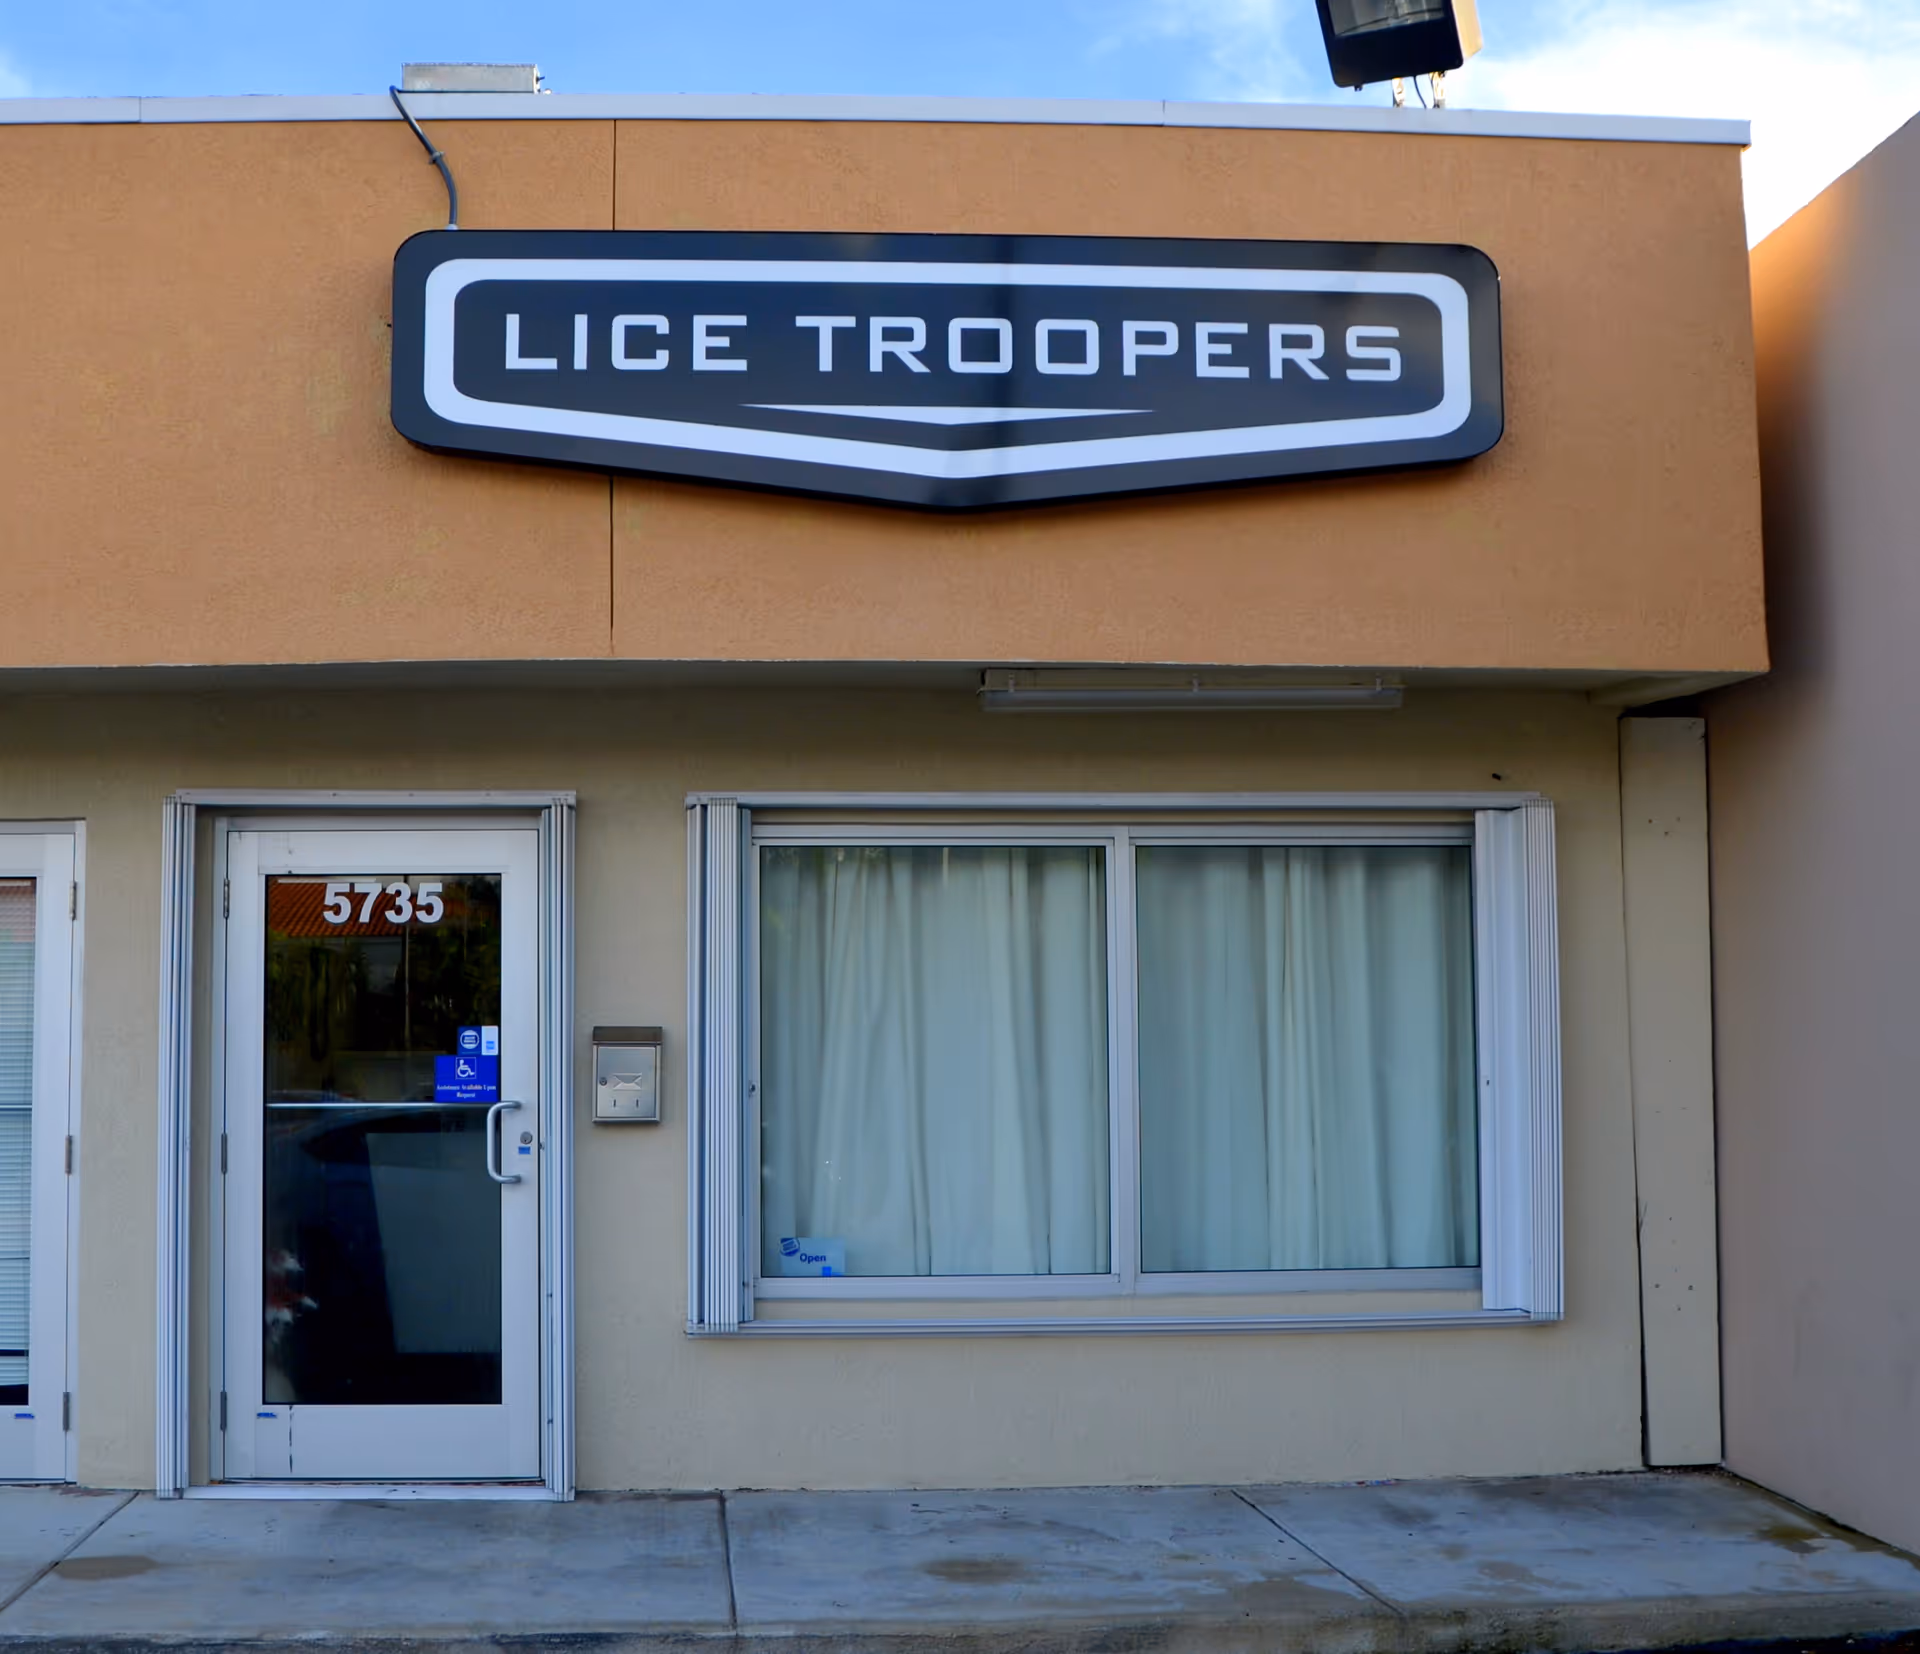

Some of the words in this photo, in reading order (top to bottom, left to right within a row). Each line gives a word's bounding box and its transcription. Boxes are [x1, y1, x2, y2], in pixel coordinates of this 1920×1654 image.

[505, 313, 748, 372] LICE
[795, 315, 1402, 381] TROOPERS
[322, 881, 444, 925] 5735
[799, 1253, 827, 1265] Open
